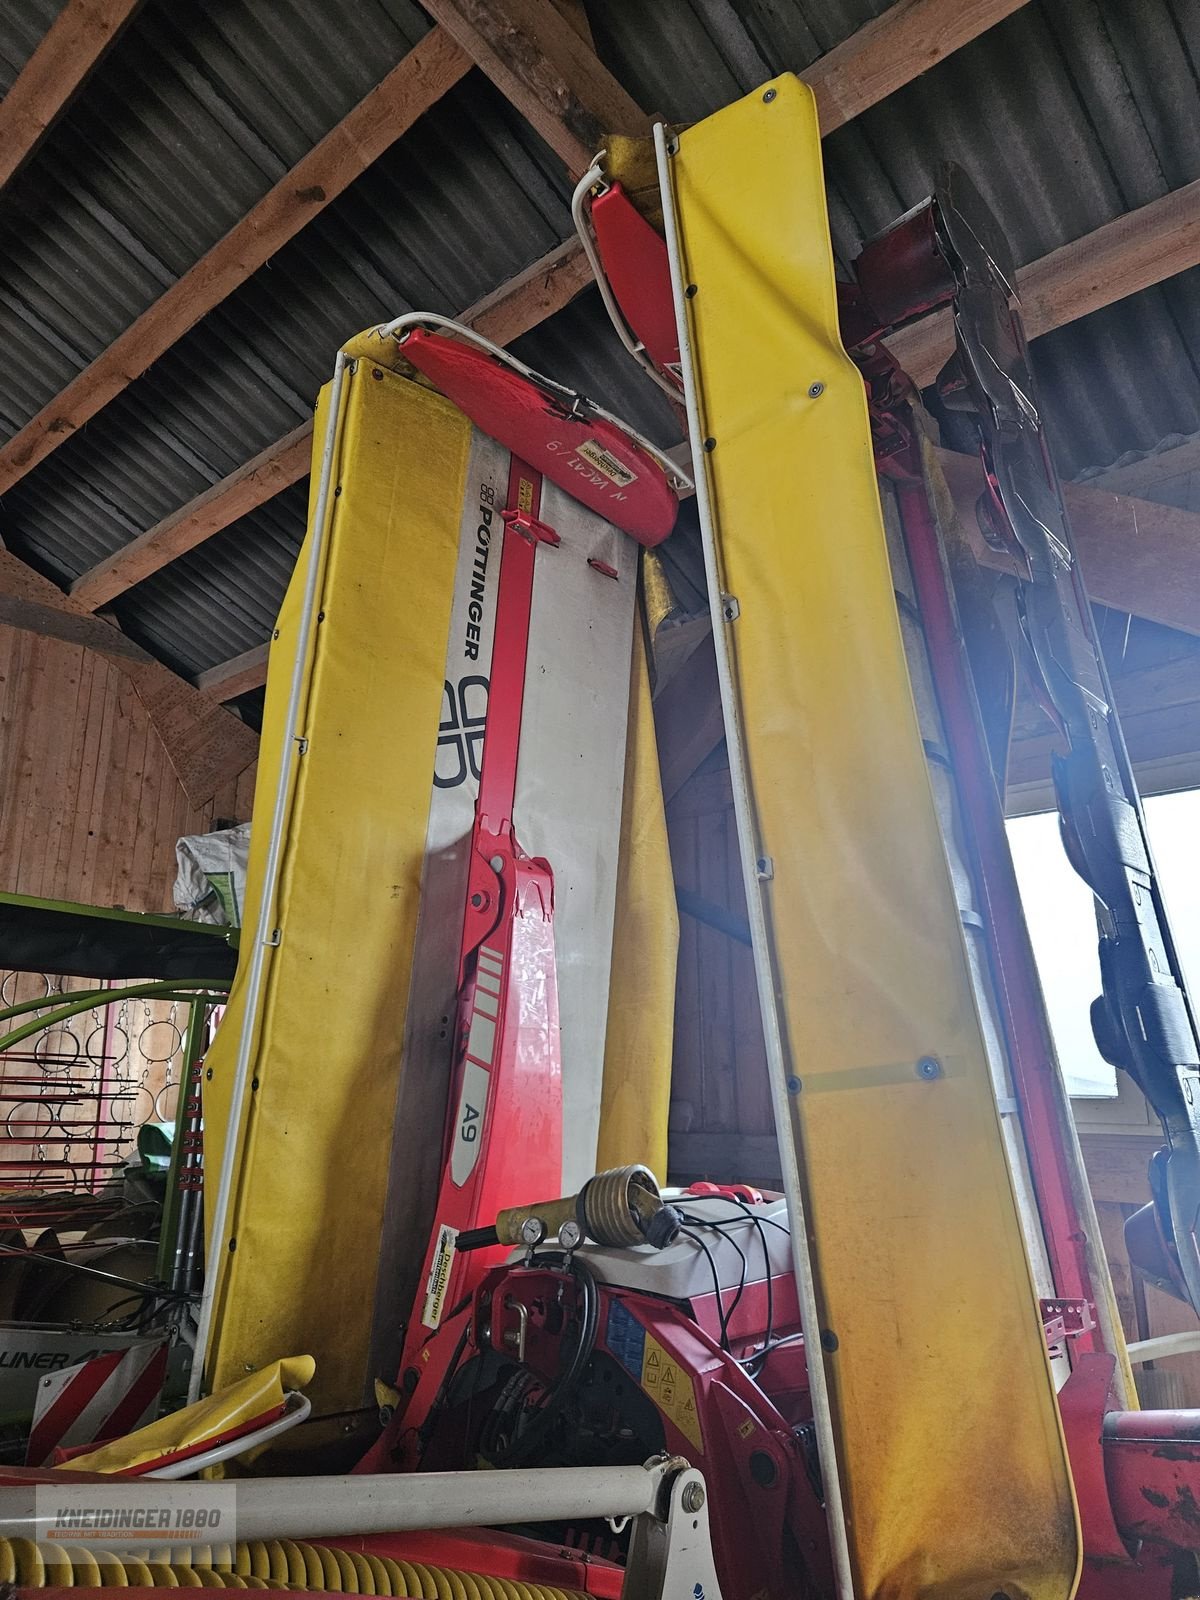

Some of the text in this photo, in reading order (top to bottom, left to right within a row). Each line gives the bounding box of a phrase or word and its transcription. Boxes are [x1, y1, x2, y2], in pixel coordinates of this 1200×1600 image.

[464, 504, 493, 662] PÖTTINGER
[461, 1103, 480, 1143] A9
[431, 1253, 451, 1321] Deschberger
[0, 1351, 69, 1370] LINER
